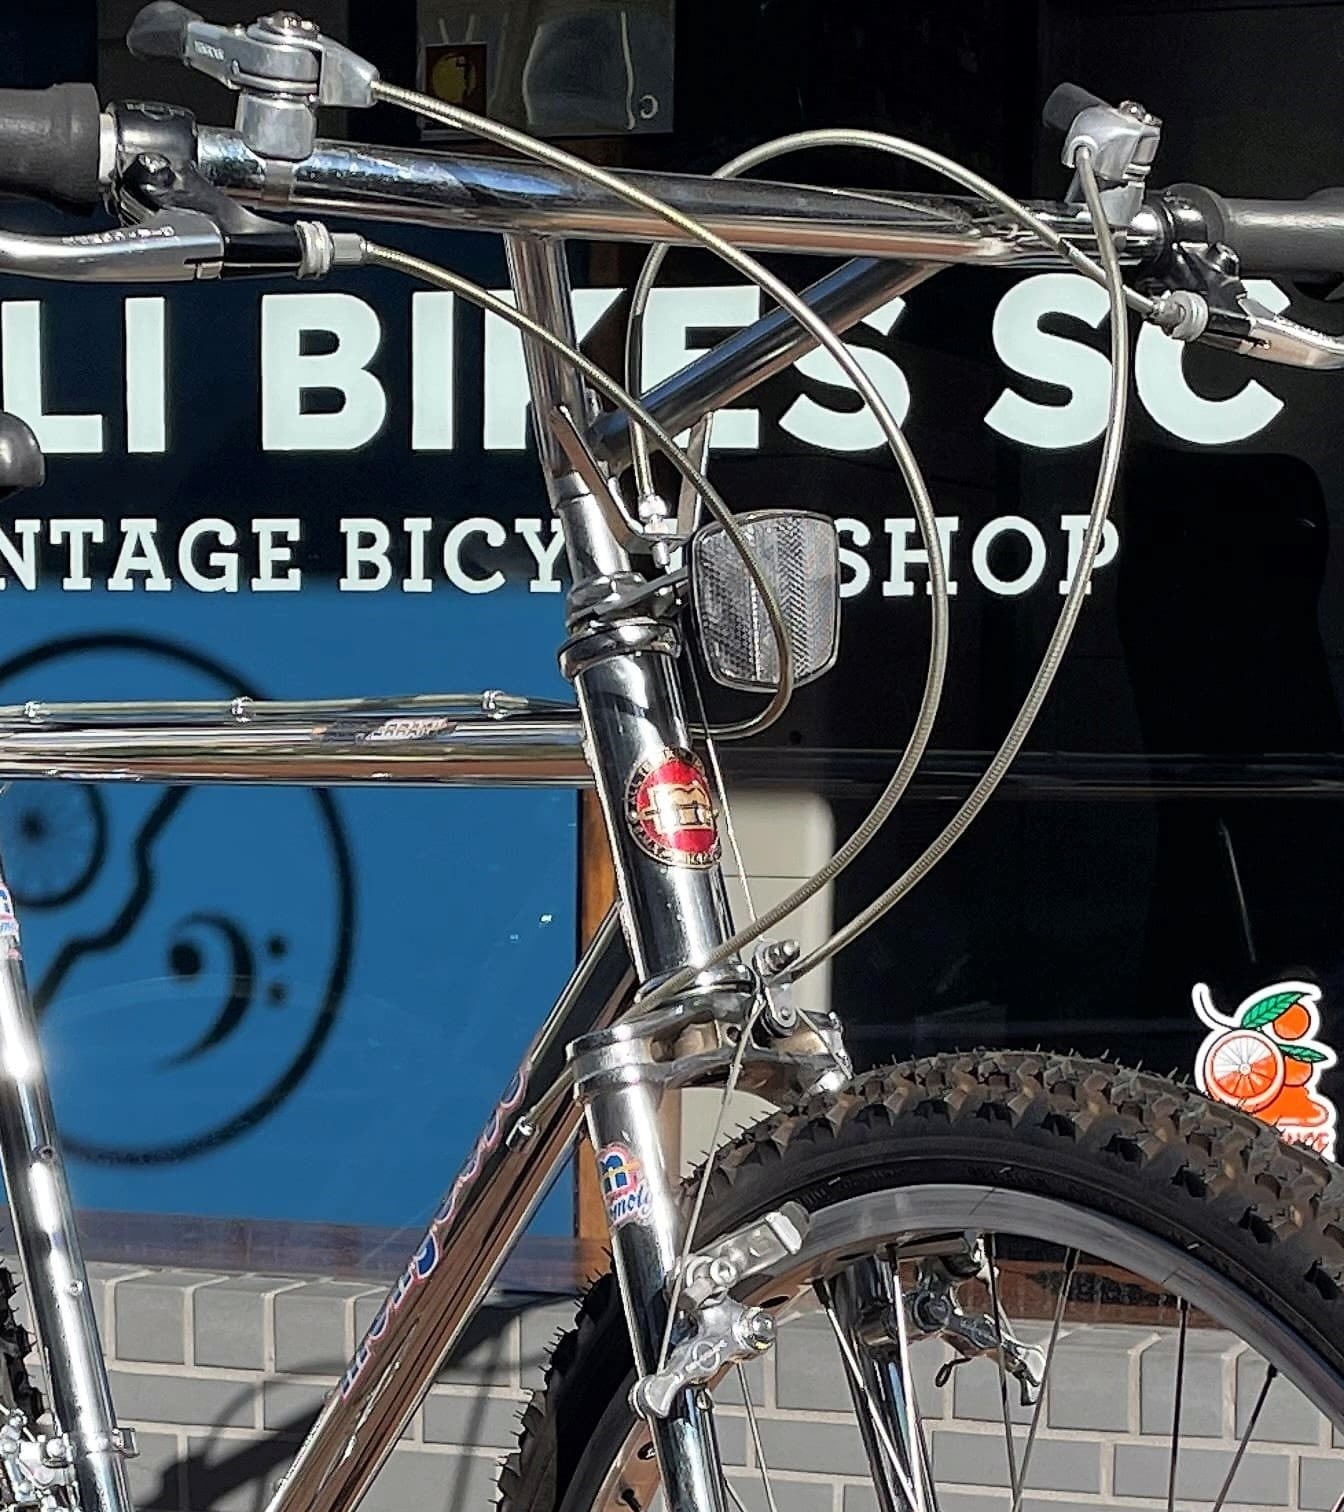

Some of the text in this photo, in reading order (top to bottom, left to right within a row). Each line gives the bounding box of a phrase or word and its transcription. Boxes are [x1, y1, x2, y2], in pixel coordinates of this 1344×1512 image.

[260, 285, 911, 452] BIKES
[983, 272, 1292, 449] SC
[339, 517, 565, 594] BICY
[834, 515, 1120, 599] SHOP
